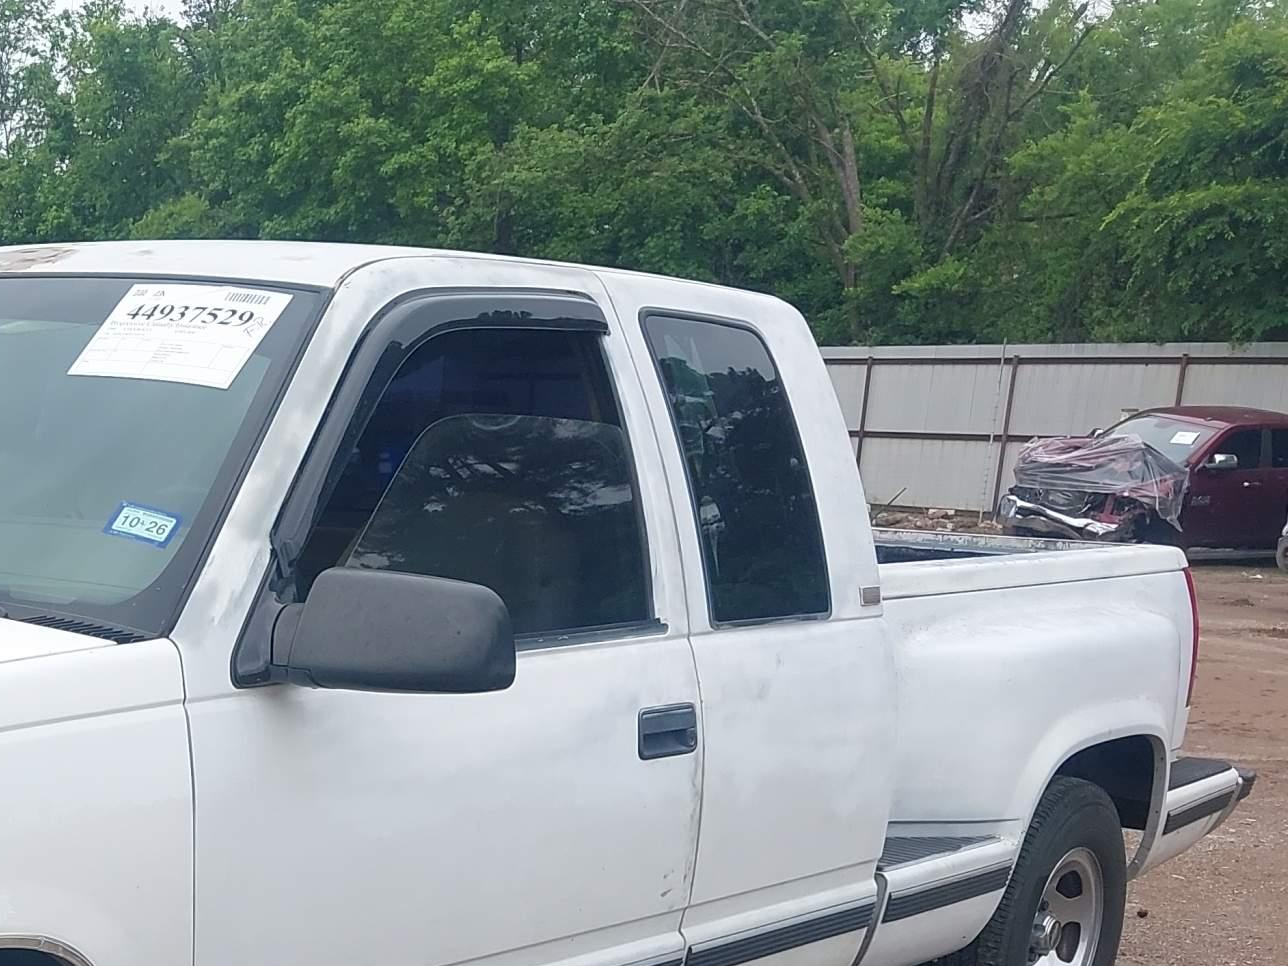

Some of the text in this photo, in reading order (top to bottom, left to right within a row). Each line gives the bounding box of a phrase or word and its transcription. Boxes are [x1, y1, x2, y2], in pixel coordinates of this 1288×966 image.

[126, 303, 255, 327] 44937529
[121, 514, 141, 528] 10
[145, 520, 169, 536] 26
